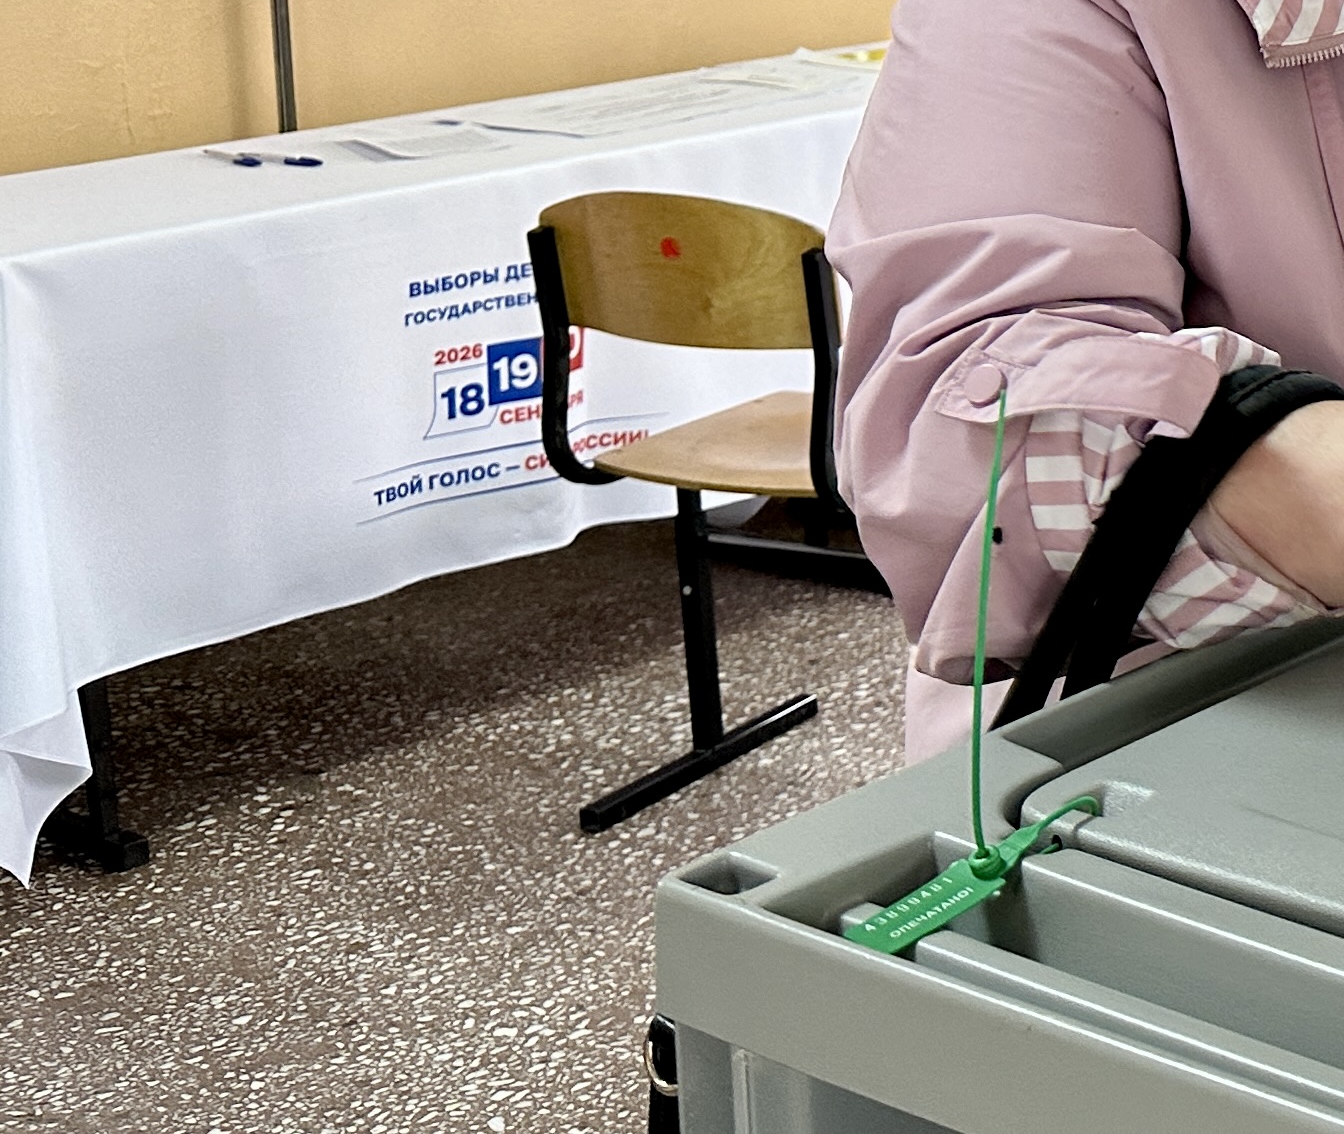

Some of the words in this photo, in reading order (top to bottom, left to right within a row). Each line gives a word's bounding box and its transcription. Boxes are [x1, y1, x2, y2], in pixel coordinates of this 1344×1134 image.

[408, 266, 499, 298] ВЫБОРЫ
[404, 293, 539, 327] ГОСУДАРСТВЕН
[434, 343, 484, 366] 2026
[440, 382, 485, 420] 18
[492, 352, 539, 393] 19
[374, 475, 423, 506] ТВОЙ
[428, 462, 502, 490] ГОЛОС
